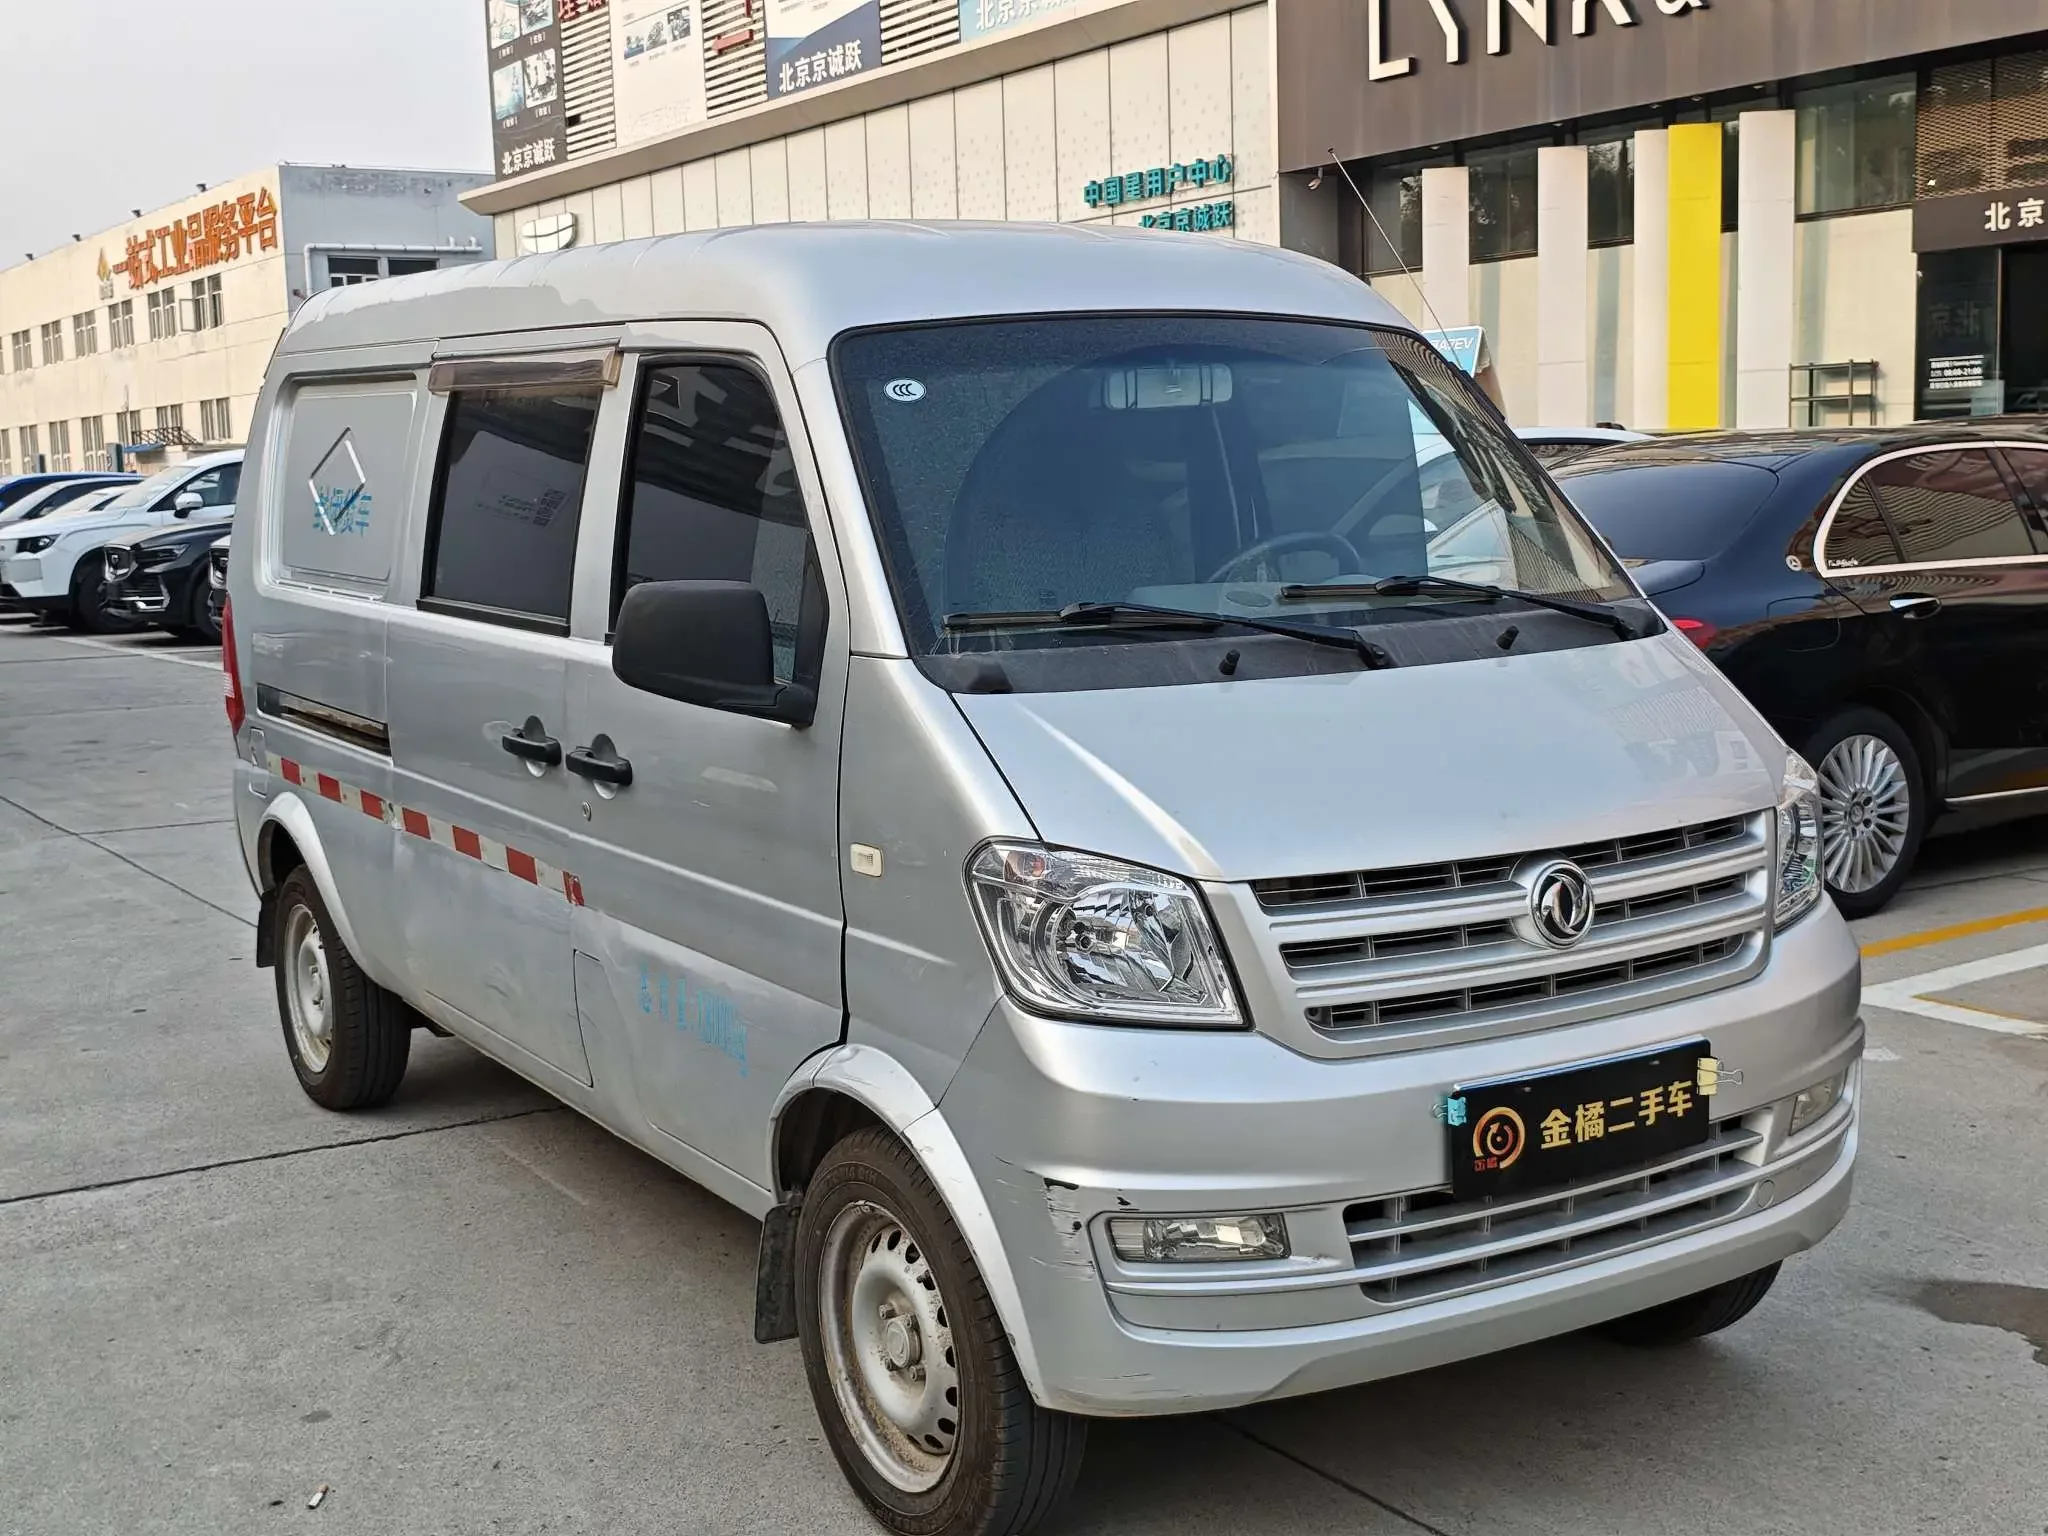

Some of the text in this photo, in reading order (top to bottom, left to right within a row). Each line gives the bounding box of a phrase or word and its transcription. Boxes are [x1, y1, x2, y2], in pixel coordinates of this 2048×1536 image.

[778, 39, 862, 93] 北京京诚跃
[502, 137, 556, 176] 北京京诚跃
[1084, 154, 1232, 208] 中国星用户中心
[1984, 198, 2046, 232] 北京
[1539, 1080, 1693, 1150] 金橘二手车
